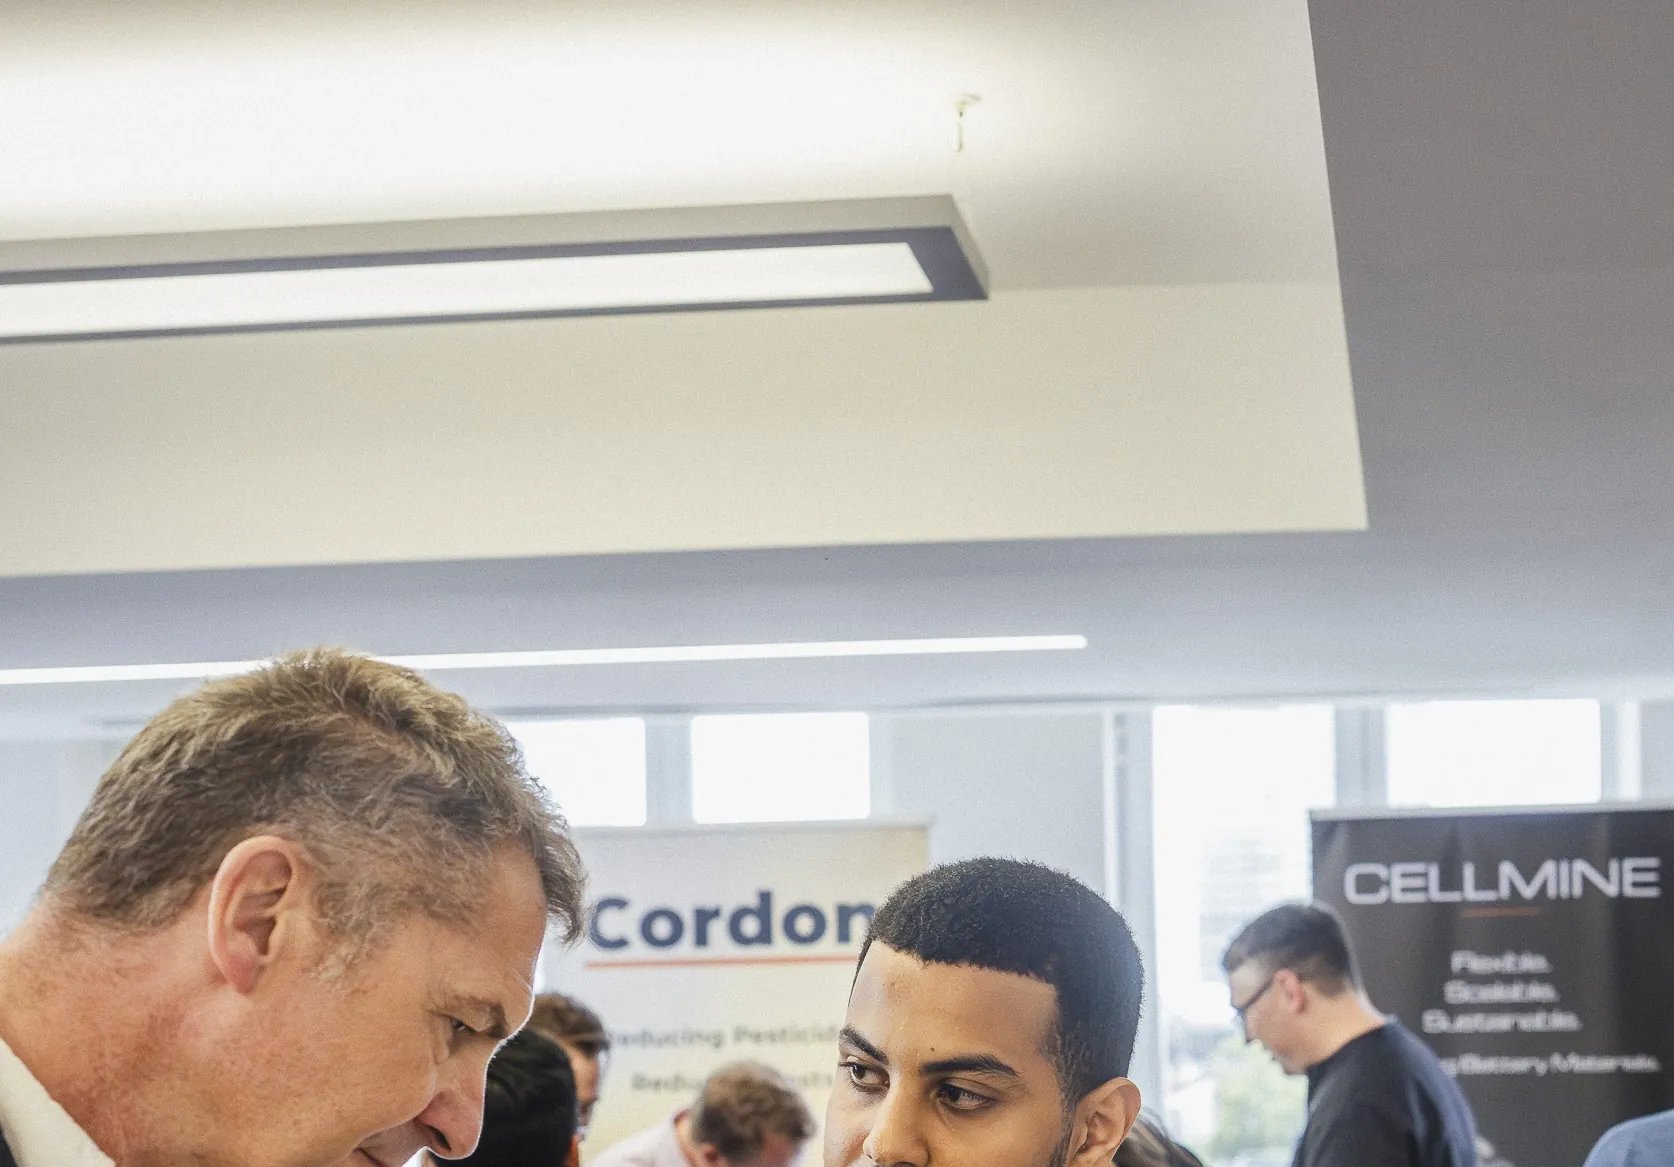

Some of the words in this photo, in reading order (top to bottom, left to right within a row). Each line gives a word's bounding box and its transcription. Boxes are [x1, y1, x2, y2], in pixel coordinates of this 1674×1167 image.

[1344, 857, 1661, 904] CELLMINE
[588, 888, 876, 950] Cordon
[612, 1027, 724, 1049] educing
